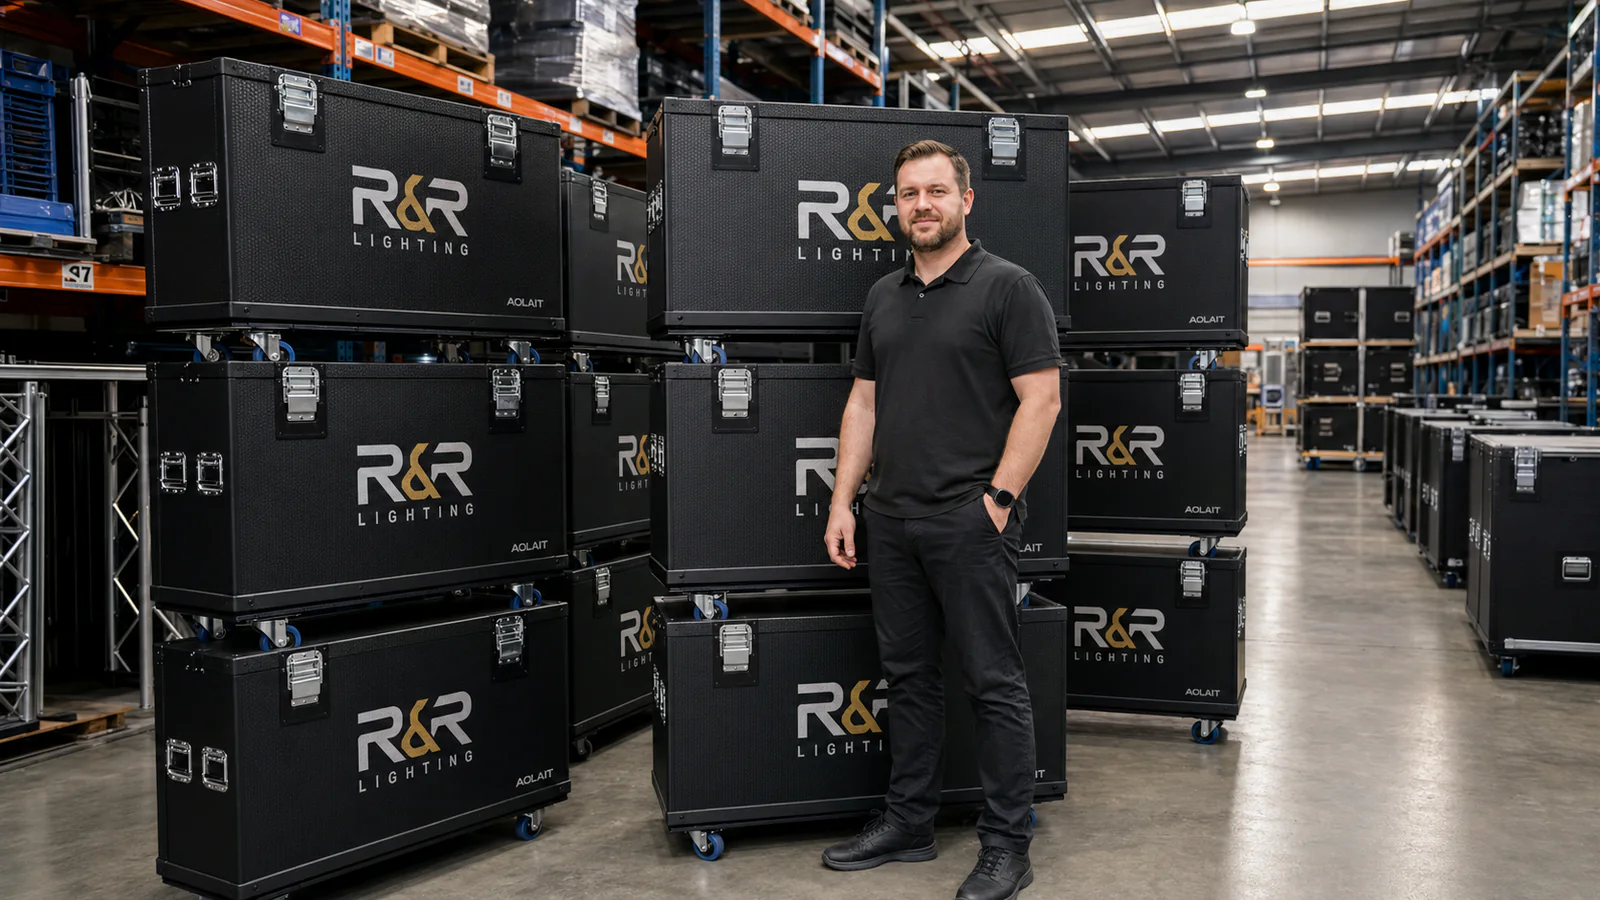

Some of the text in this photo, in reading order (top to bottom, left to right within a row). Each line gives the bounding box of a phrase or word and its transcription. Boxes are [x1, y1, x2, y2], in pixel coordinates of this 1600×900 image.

[352, 165, 468, 236] R&R
[353, 231, 469, 256] LIGHTING
[1075, 235, 1166, 276] R&R
[616, 239, 648, 284] R&
[1074, 279, 1165, 291] LIGHTING
[506, 297, 544, 308] AOLAIT
[1188, 315, 1225, 324] AOLAIT
[618, 434, 650, 477] R&
[1077, 426, 1165, 466] R&R
[357, 442, 472, 505] R&R
[1076, 469, 1164, 480] LIGHTING
[357, 502, 474, 527] LIGHTING
[1184, 505, 1221, 514] AOLAIT
[510, 540, 549, 553] AOLAIT
[620, 605, 655, 658] R&
[1075, 607, 1165, 649] R&R
[1074, 651, 1164, 664] LIGHTING
[1185, 688, 1221, 697] AOLAIT
[358, 691, 473, 772] R&R
[358, 749, 473, 793] LIGHTING
[515, 768, 554, 788] AOLAIT
